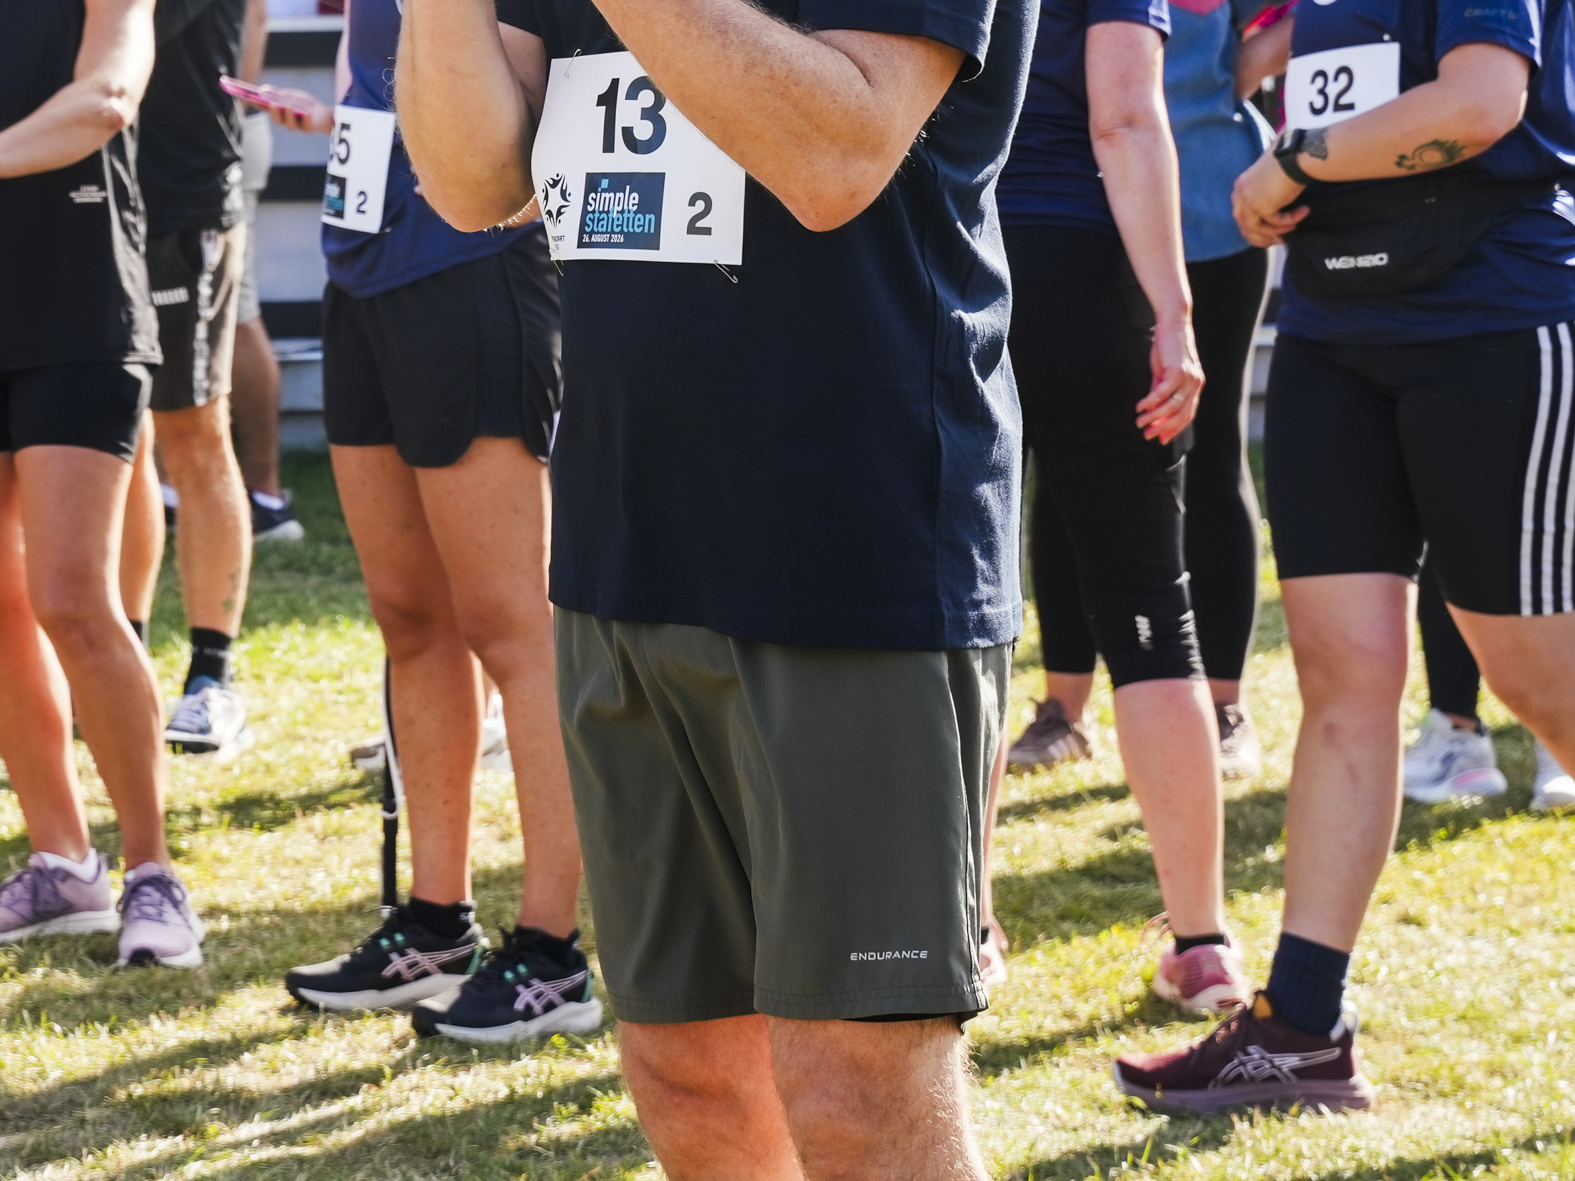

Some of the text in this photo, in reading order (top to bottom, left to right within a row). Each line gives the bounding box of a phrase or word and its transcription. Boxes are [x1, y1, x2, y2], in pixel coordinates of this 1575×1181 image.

[1309, 66, 1355, 115] 32
[596, 76, 667, 155] 13
[329, 122, 351, 165] 5
[356, 190, 367, 214] 2
[587, 179, 639, 218] simple
[687, 192, 713, 236] 2
[584, 208, 656, 234] stafetten
[591, 234, 610, 243] AUGUST
[850, 950, 929, 961] ENDURANCE
